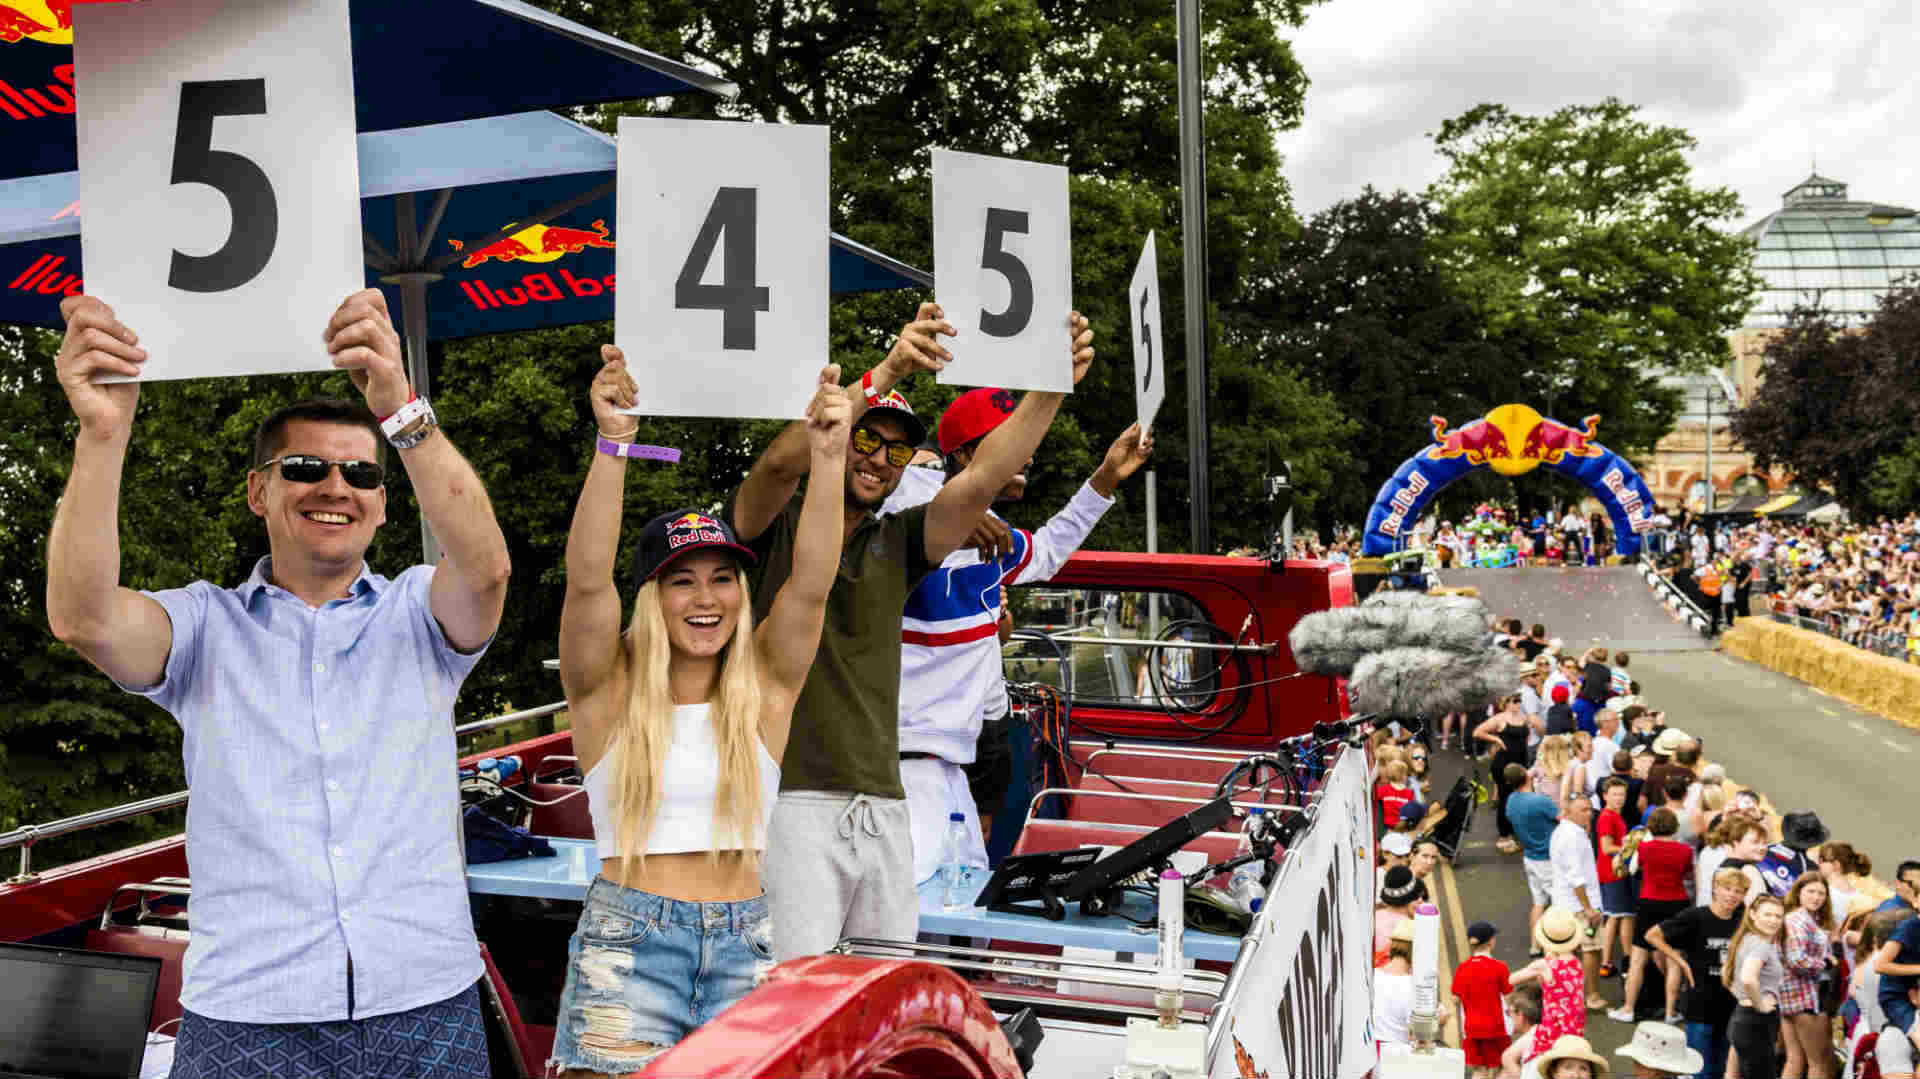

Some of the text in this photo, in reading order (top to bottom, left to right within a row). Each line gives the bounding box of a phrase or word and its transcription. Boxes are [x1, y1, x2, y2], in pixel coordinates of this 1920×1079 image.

[168, 78, 278, 292] 5
[675, 186, 770, 350] 4
[979, 207, 1034, 337] 5
[1140, 285, 1152, 392] 5
[670, 530, 727, 548] Red Bull
[1379, 472, 1428, 535] Red Bull
[1602, 468, 1639, 504] Red
